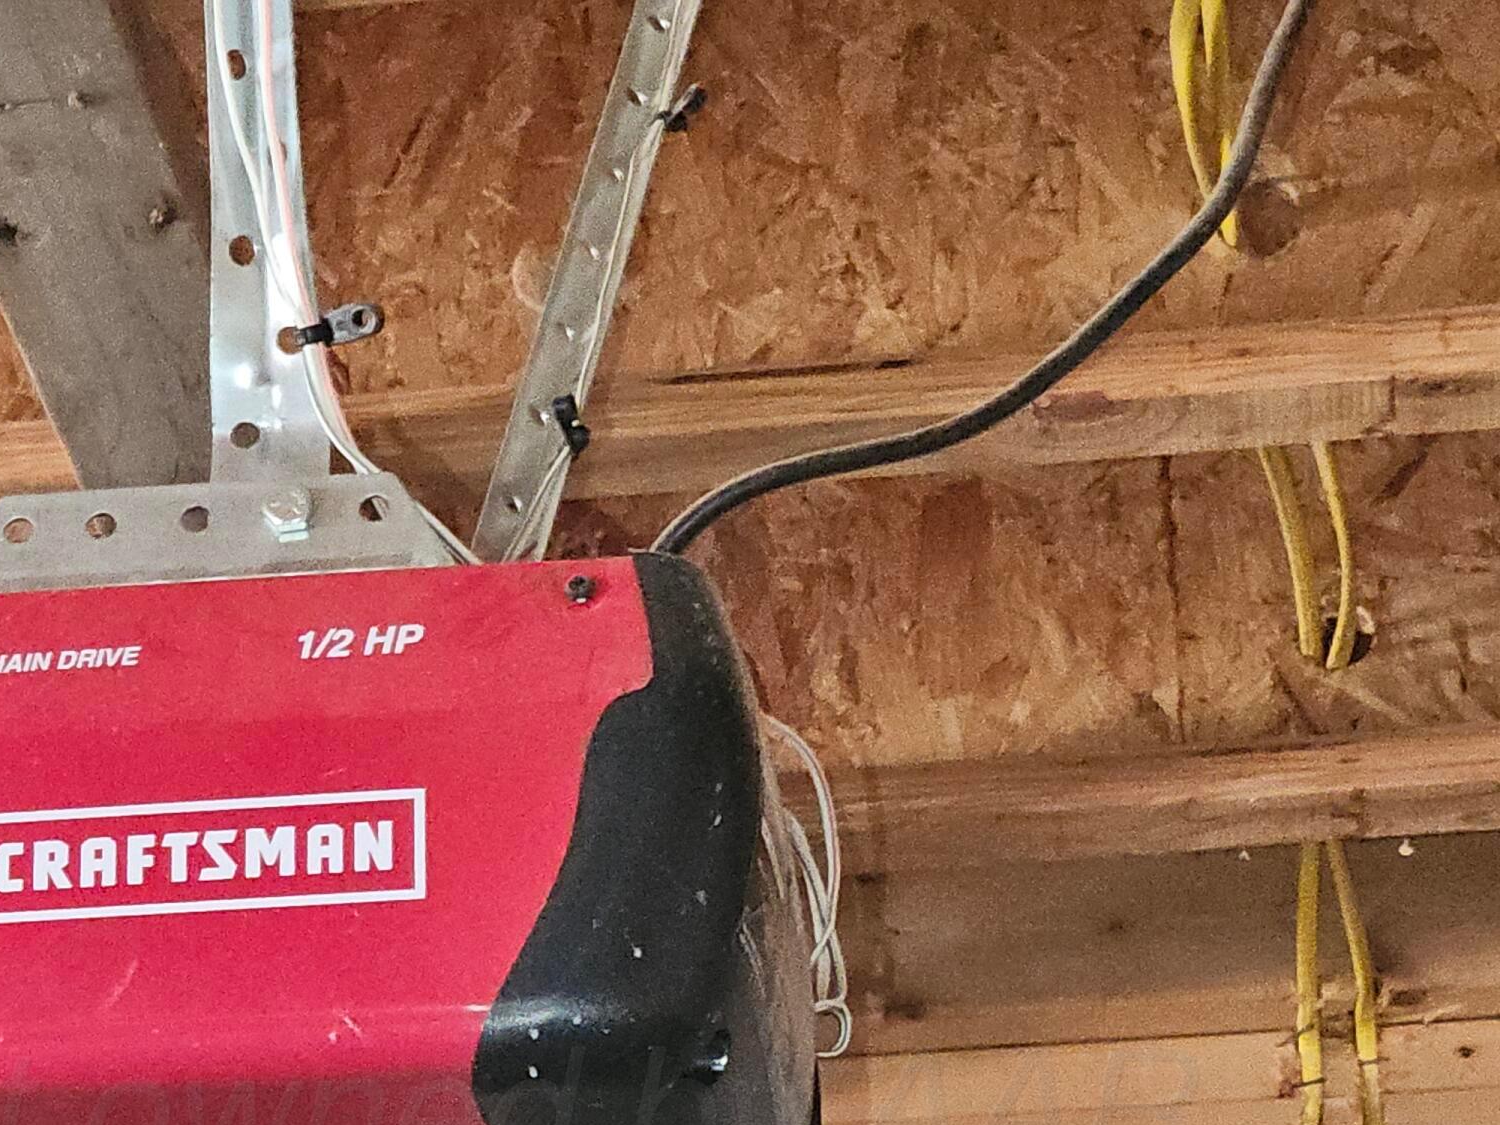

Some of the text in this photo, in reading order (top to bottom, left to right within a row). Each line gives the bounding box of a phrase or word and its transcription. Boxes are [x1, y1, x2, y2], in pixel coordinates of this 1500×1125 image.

[297, 623, 425, 660] 1/2 HP
[56, 645, 142, 671] DRIVE
